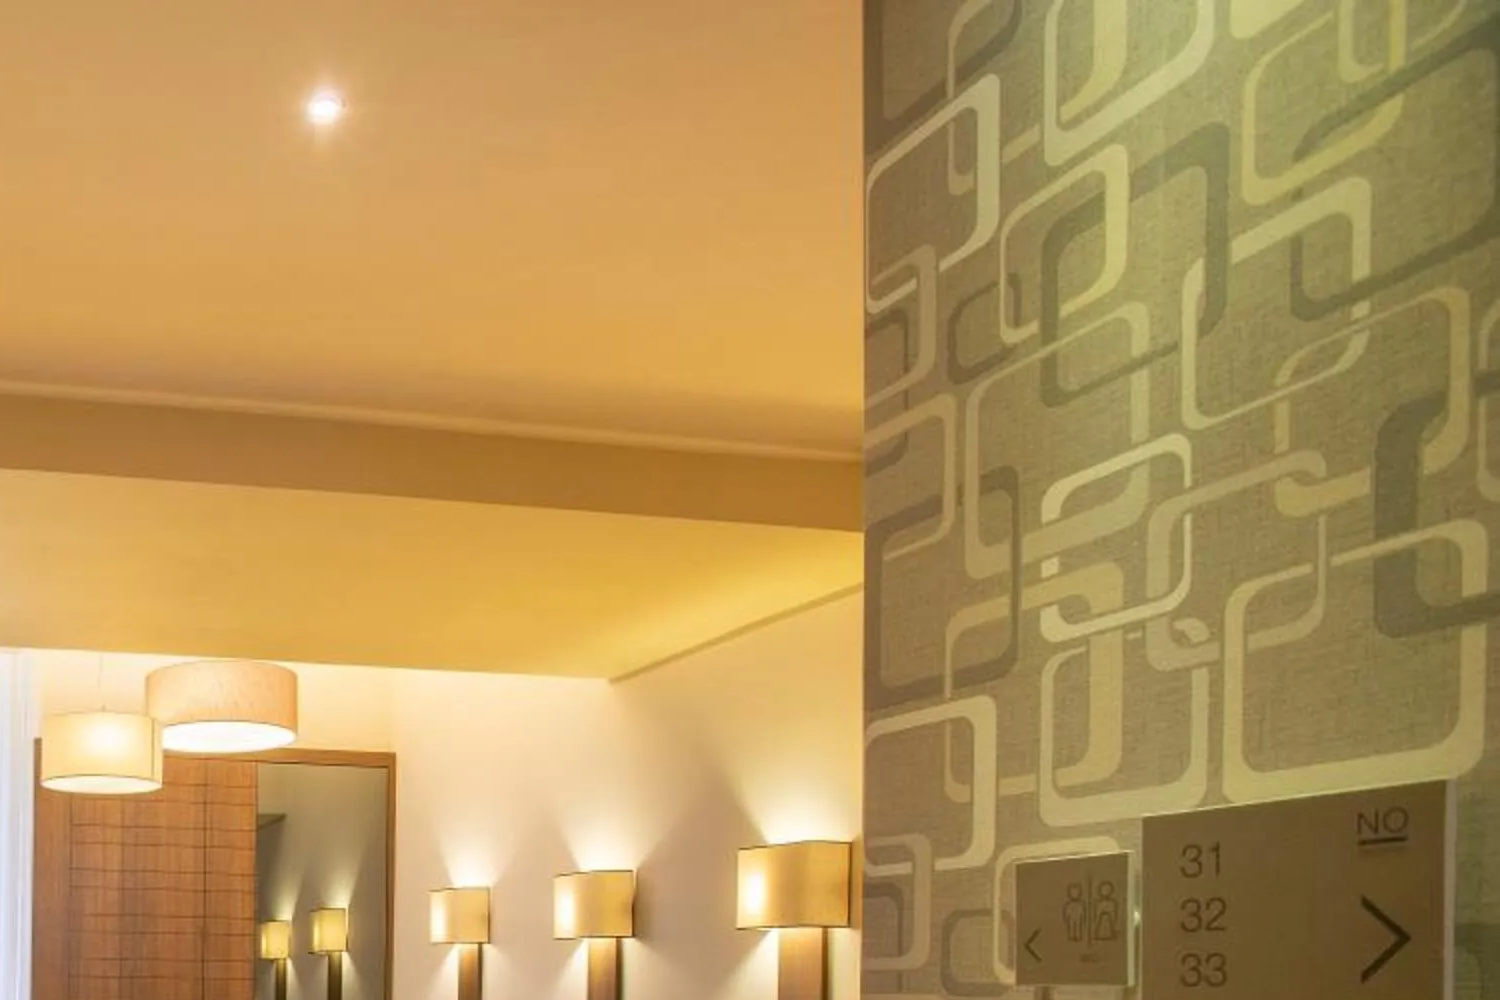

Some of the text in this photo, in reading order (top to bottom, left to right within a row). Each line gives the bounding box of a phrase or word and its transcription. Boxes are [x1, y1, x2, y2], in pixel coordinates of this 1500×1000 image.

[1180, 841, 1222, 879] 31
[1180, 897, 1228, 933] 32
[1180, 952, 1228, 988] 33
